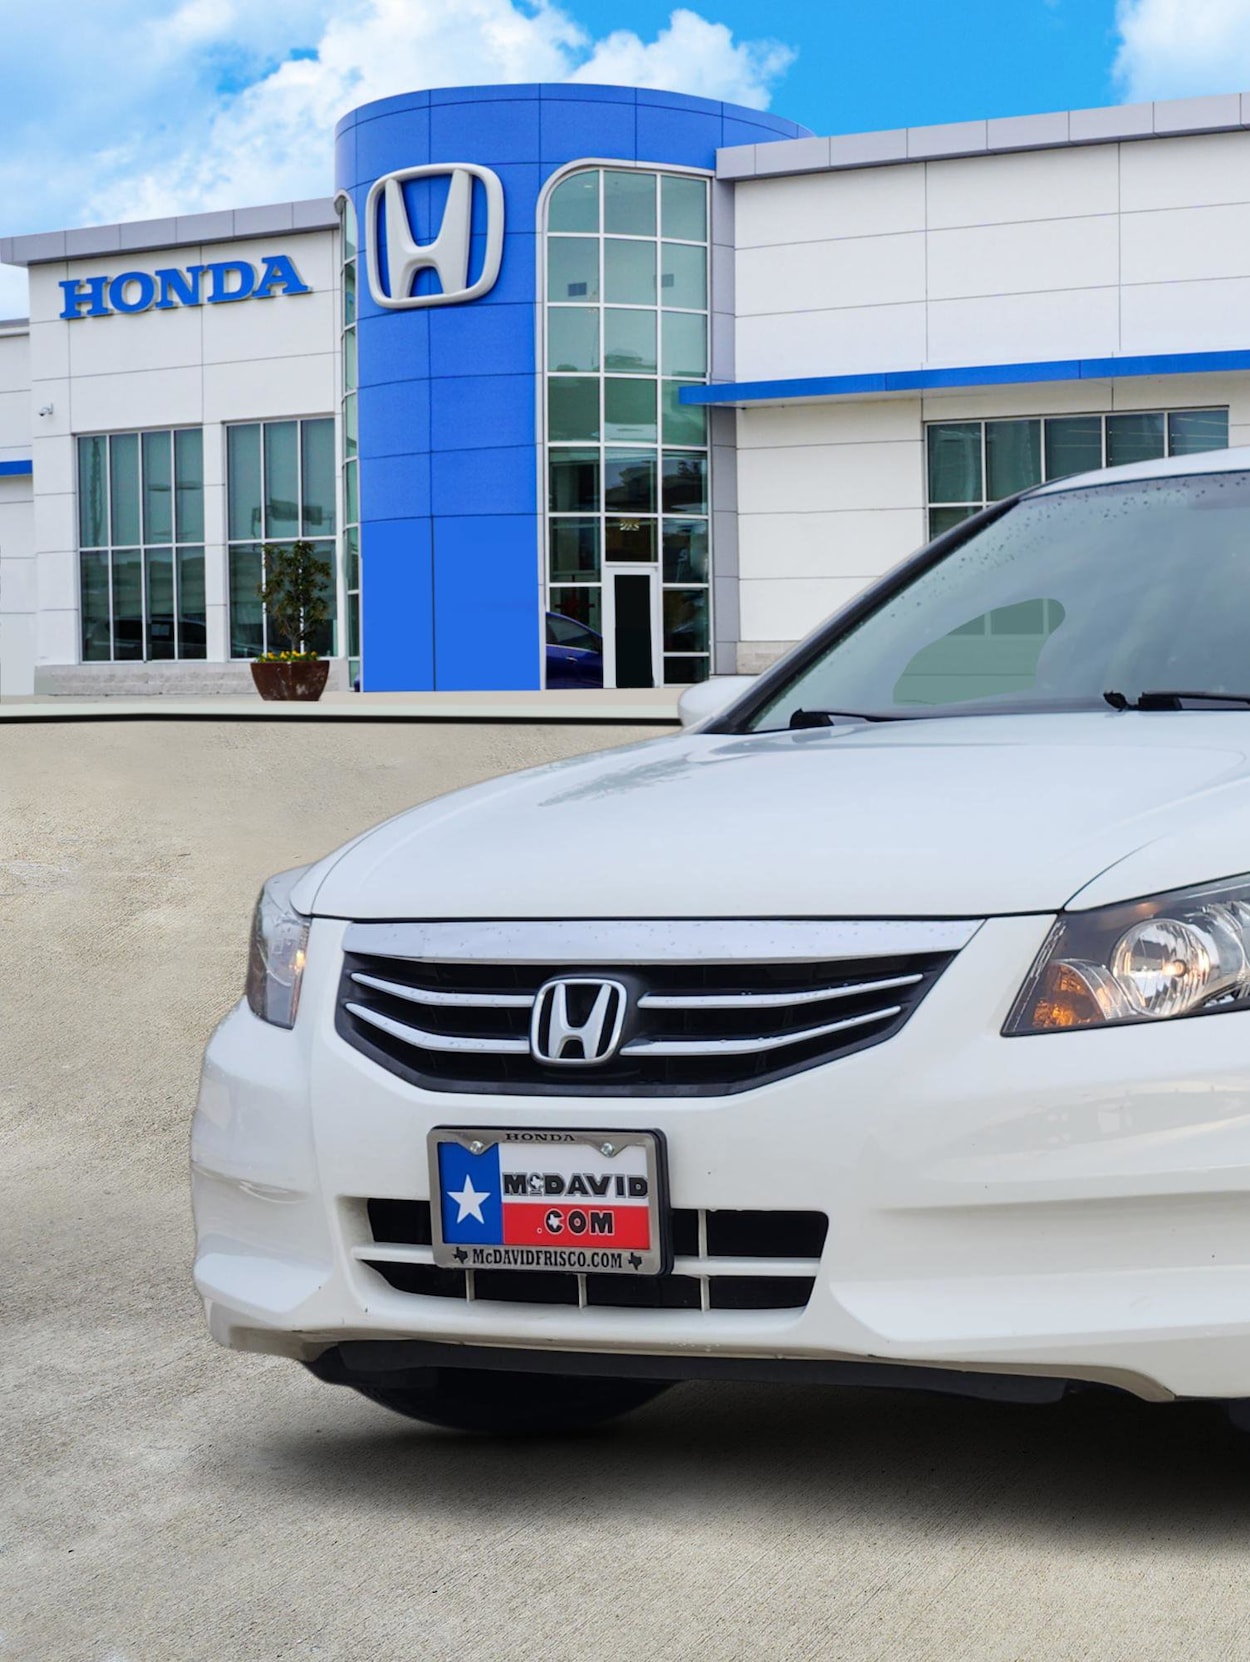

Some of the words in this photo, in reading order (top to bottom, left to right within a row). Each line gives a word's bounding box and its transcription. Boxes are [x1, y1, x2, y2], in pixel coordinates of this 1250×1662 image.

[59, 254, 312, 320] HONDA
[505, 1132, 576, 1142] HONDA
[472, 1248, 623, 1269] McDAVIDFRISCO.COM
